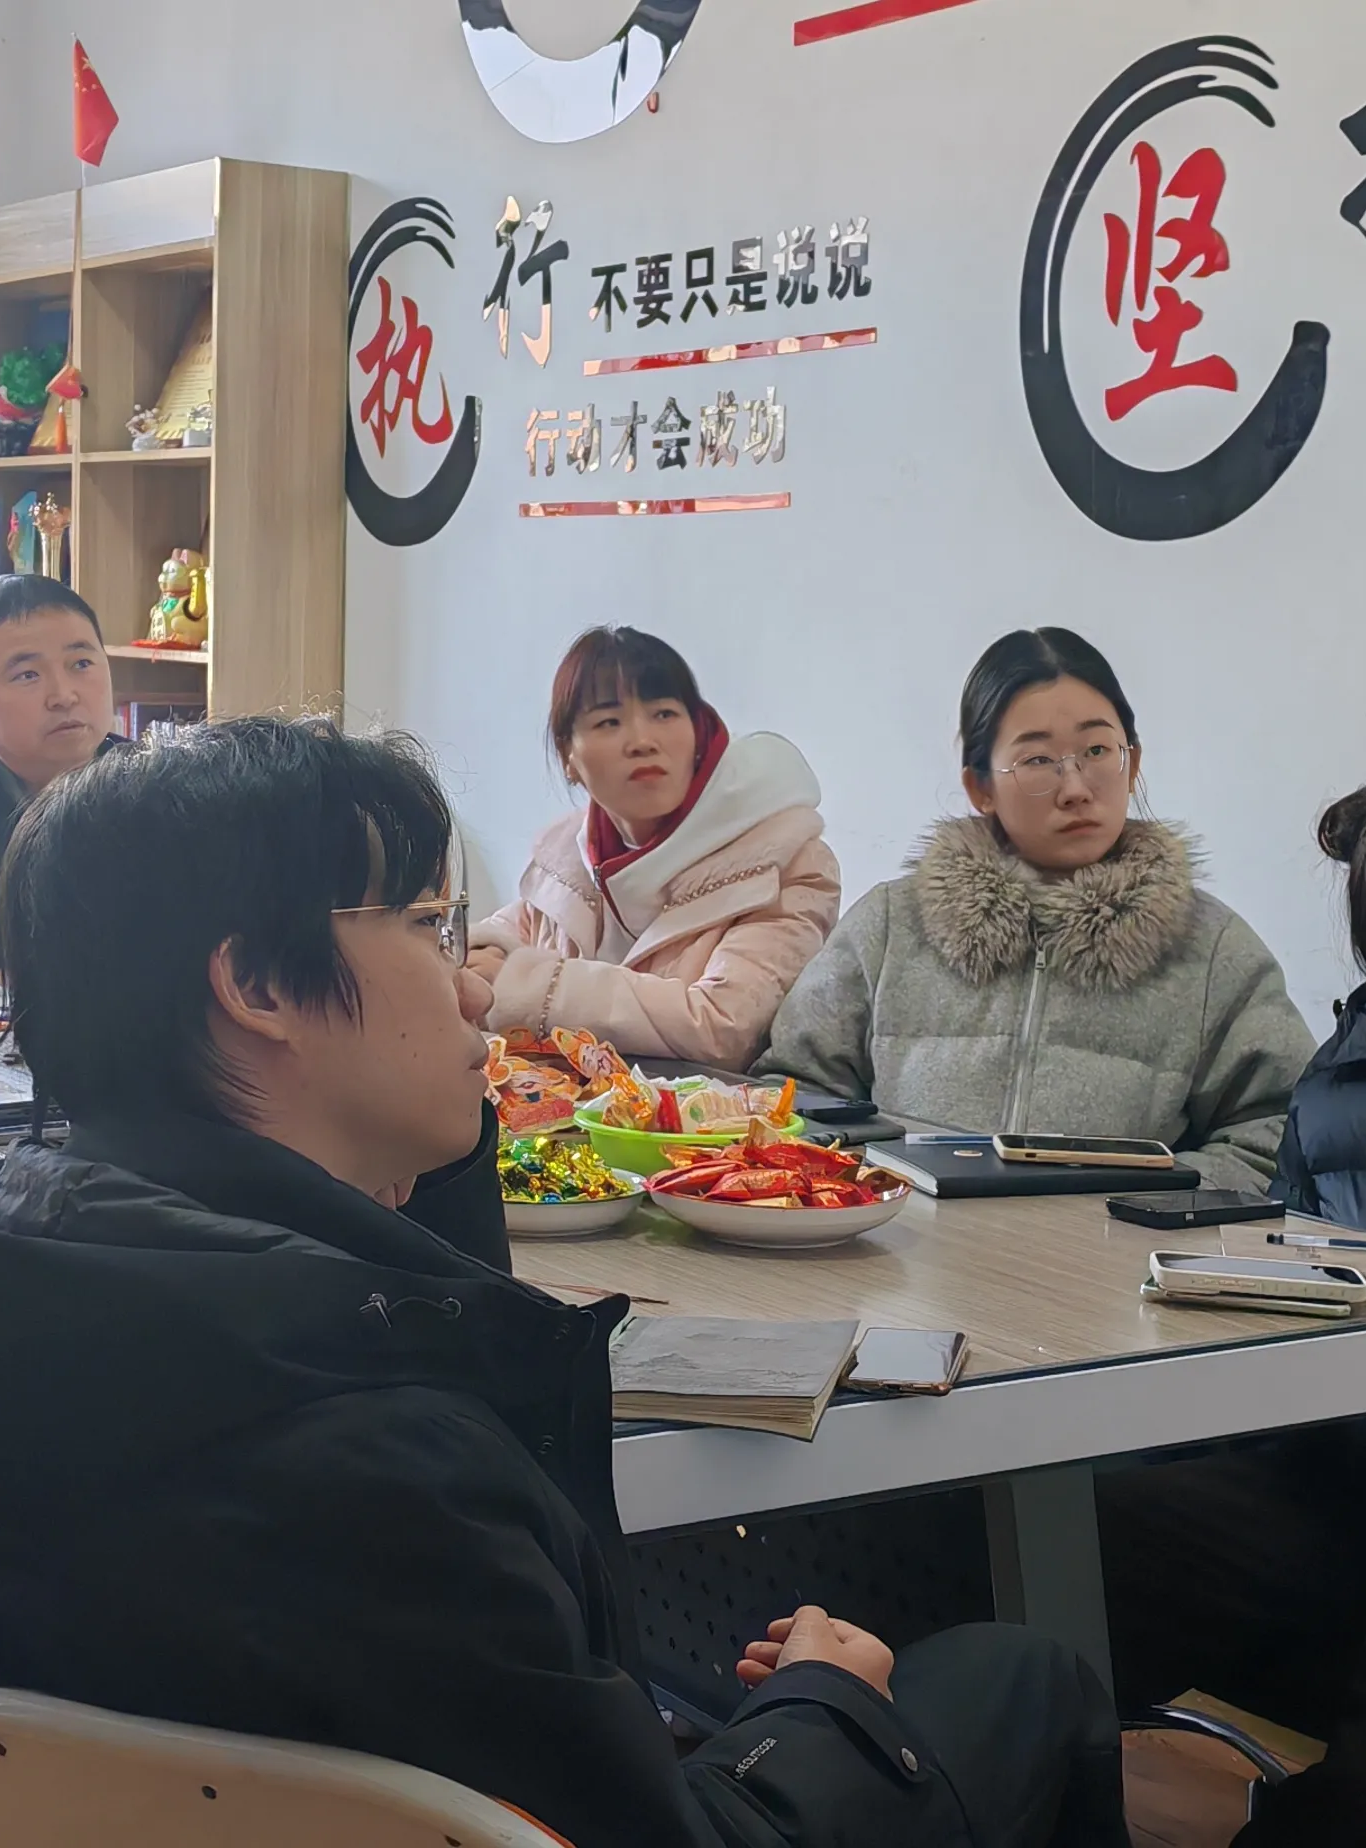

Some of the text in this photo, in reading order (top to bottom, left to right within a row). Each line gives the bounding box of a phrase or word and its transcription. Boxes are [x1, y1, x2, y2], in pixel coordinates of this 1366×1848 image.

[355, 195, 570, 460] 执 行
[588, 215, 873, 333] 不要只是说说
[1103, 140, 1238, 422] 坚
[525, 386, 786, 477] 行动才会成功
